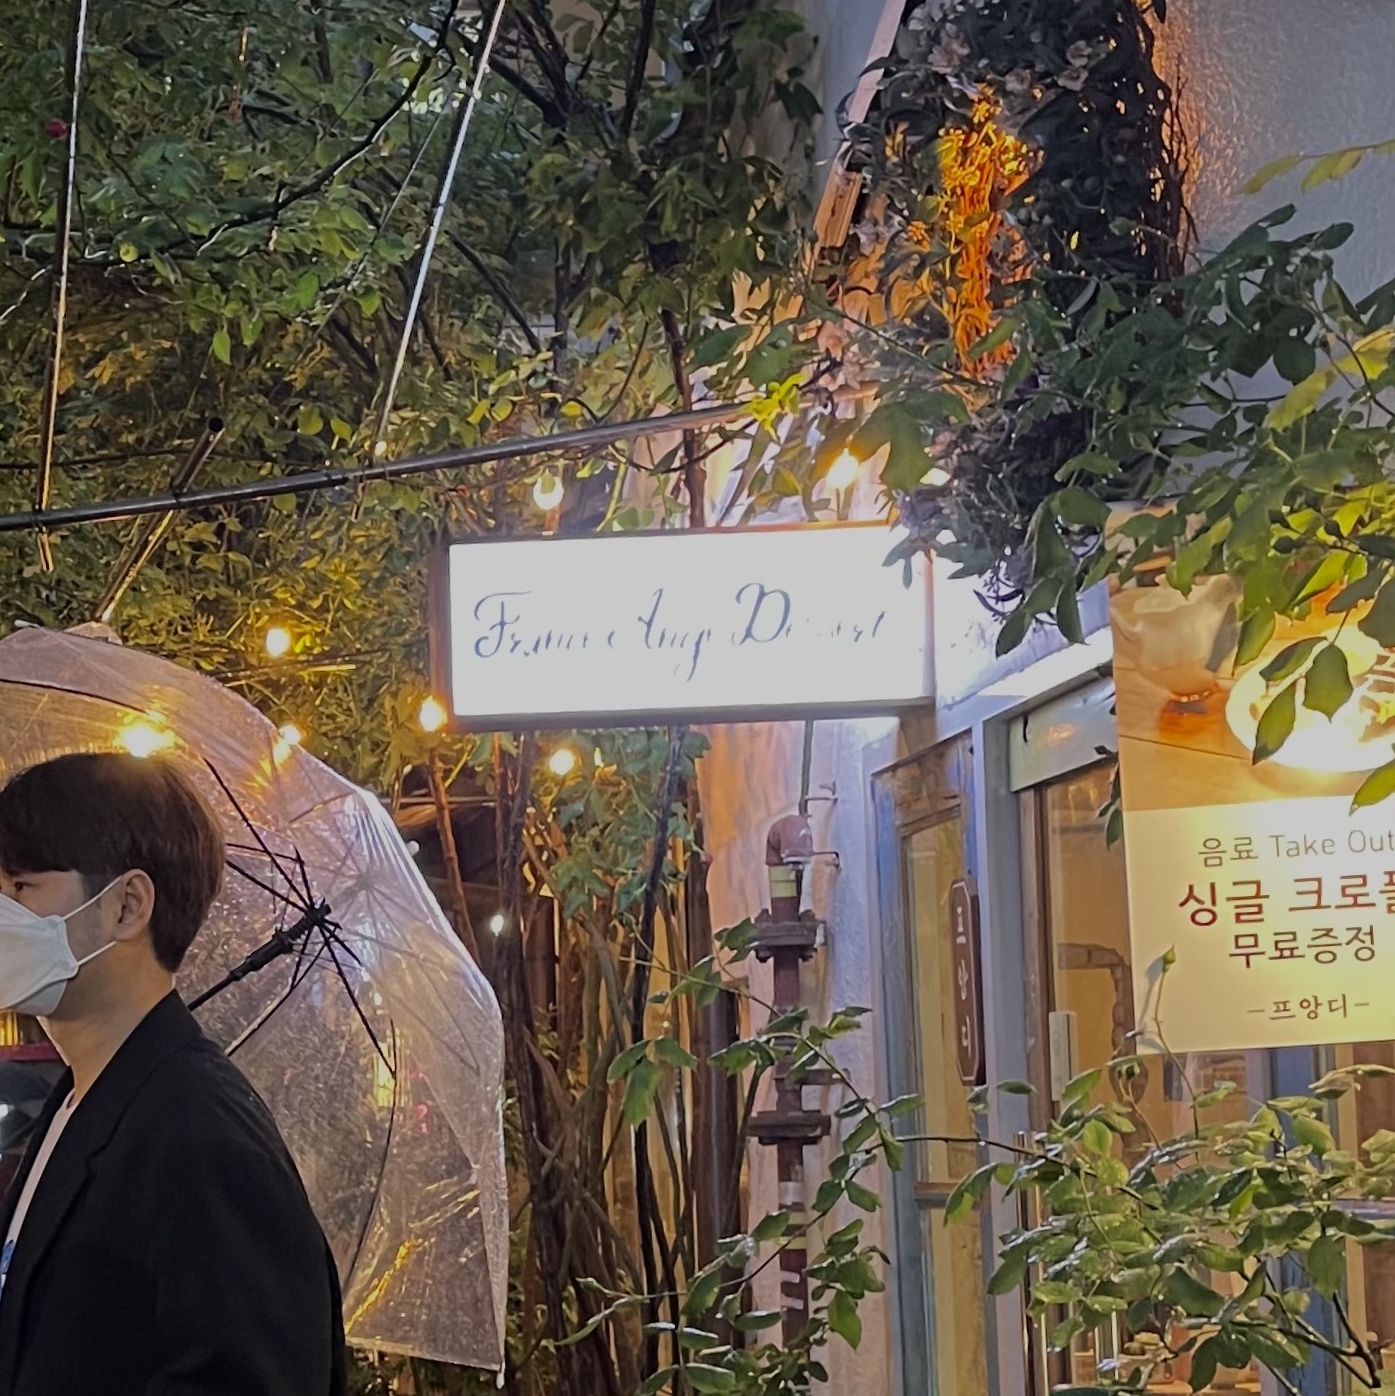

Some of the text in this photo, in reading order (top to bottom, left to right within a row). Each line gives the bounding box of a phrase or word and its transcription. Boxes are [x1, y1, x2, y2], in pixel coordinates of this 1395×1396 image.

[1198, 829, 1395, 868] 음료 Take Out
[1178, 879, 1270, 927] 싱글
[1228, 924, 1377, 969] 무료증정
